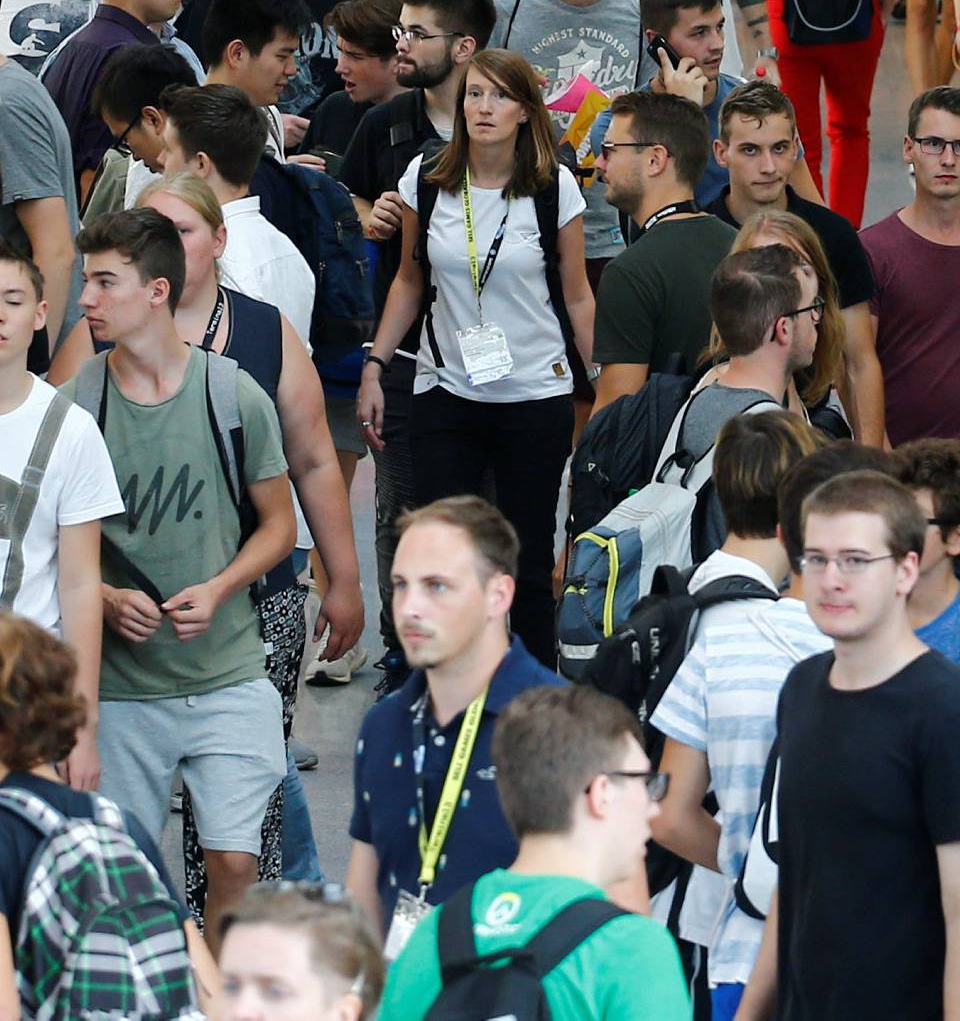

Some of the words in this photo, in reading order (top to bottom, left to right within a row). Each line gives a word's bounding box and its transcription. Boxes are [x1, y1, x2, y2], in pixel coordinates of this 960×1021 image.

[531, 29, 574, 55] HIGHEST
[579, 27, 630, 58] STANDARD
[206, 302, 224, 335] Terminal3
